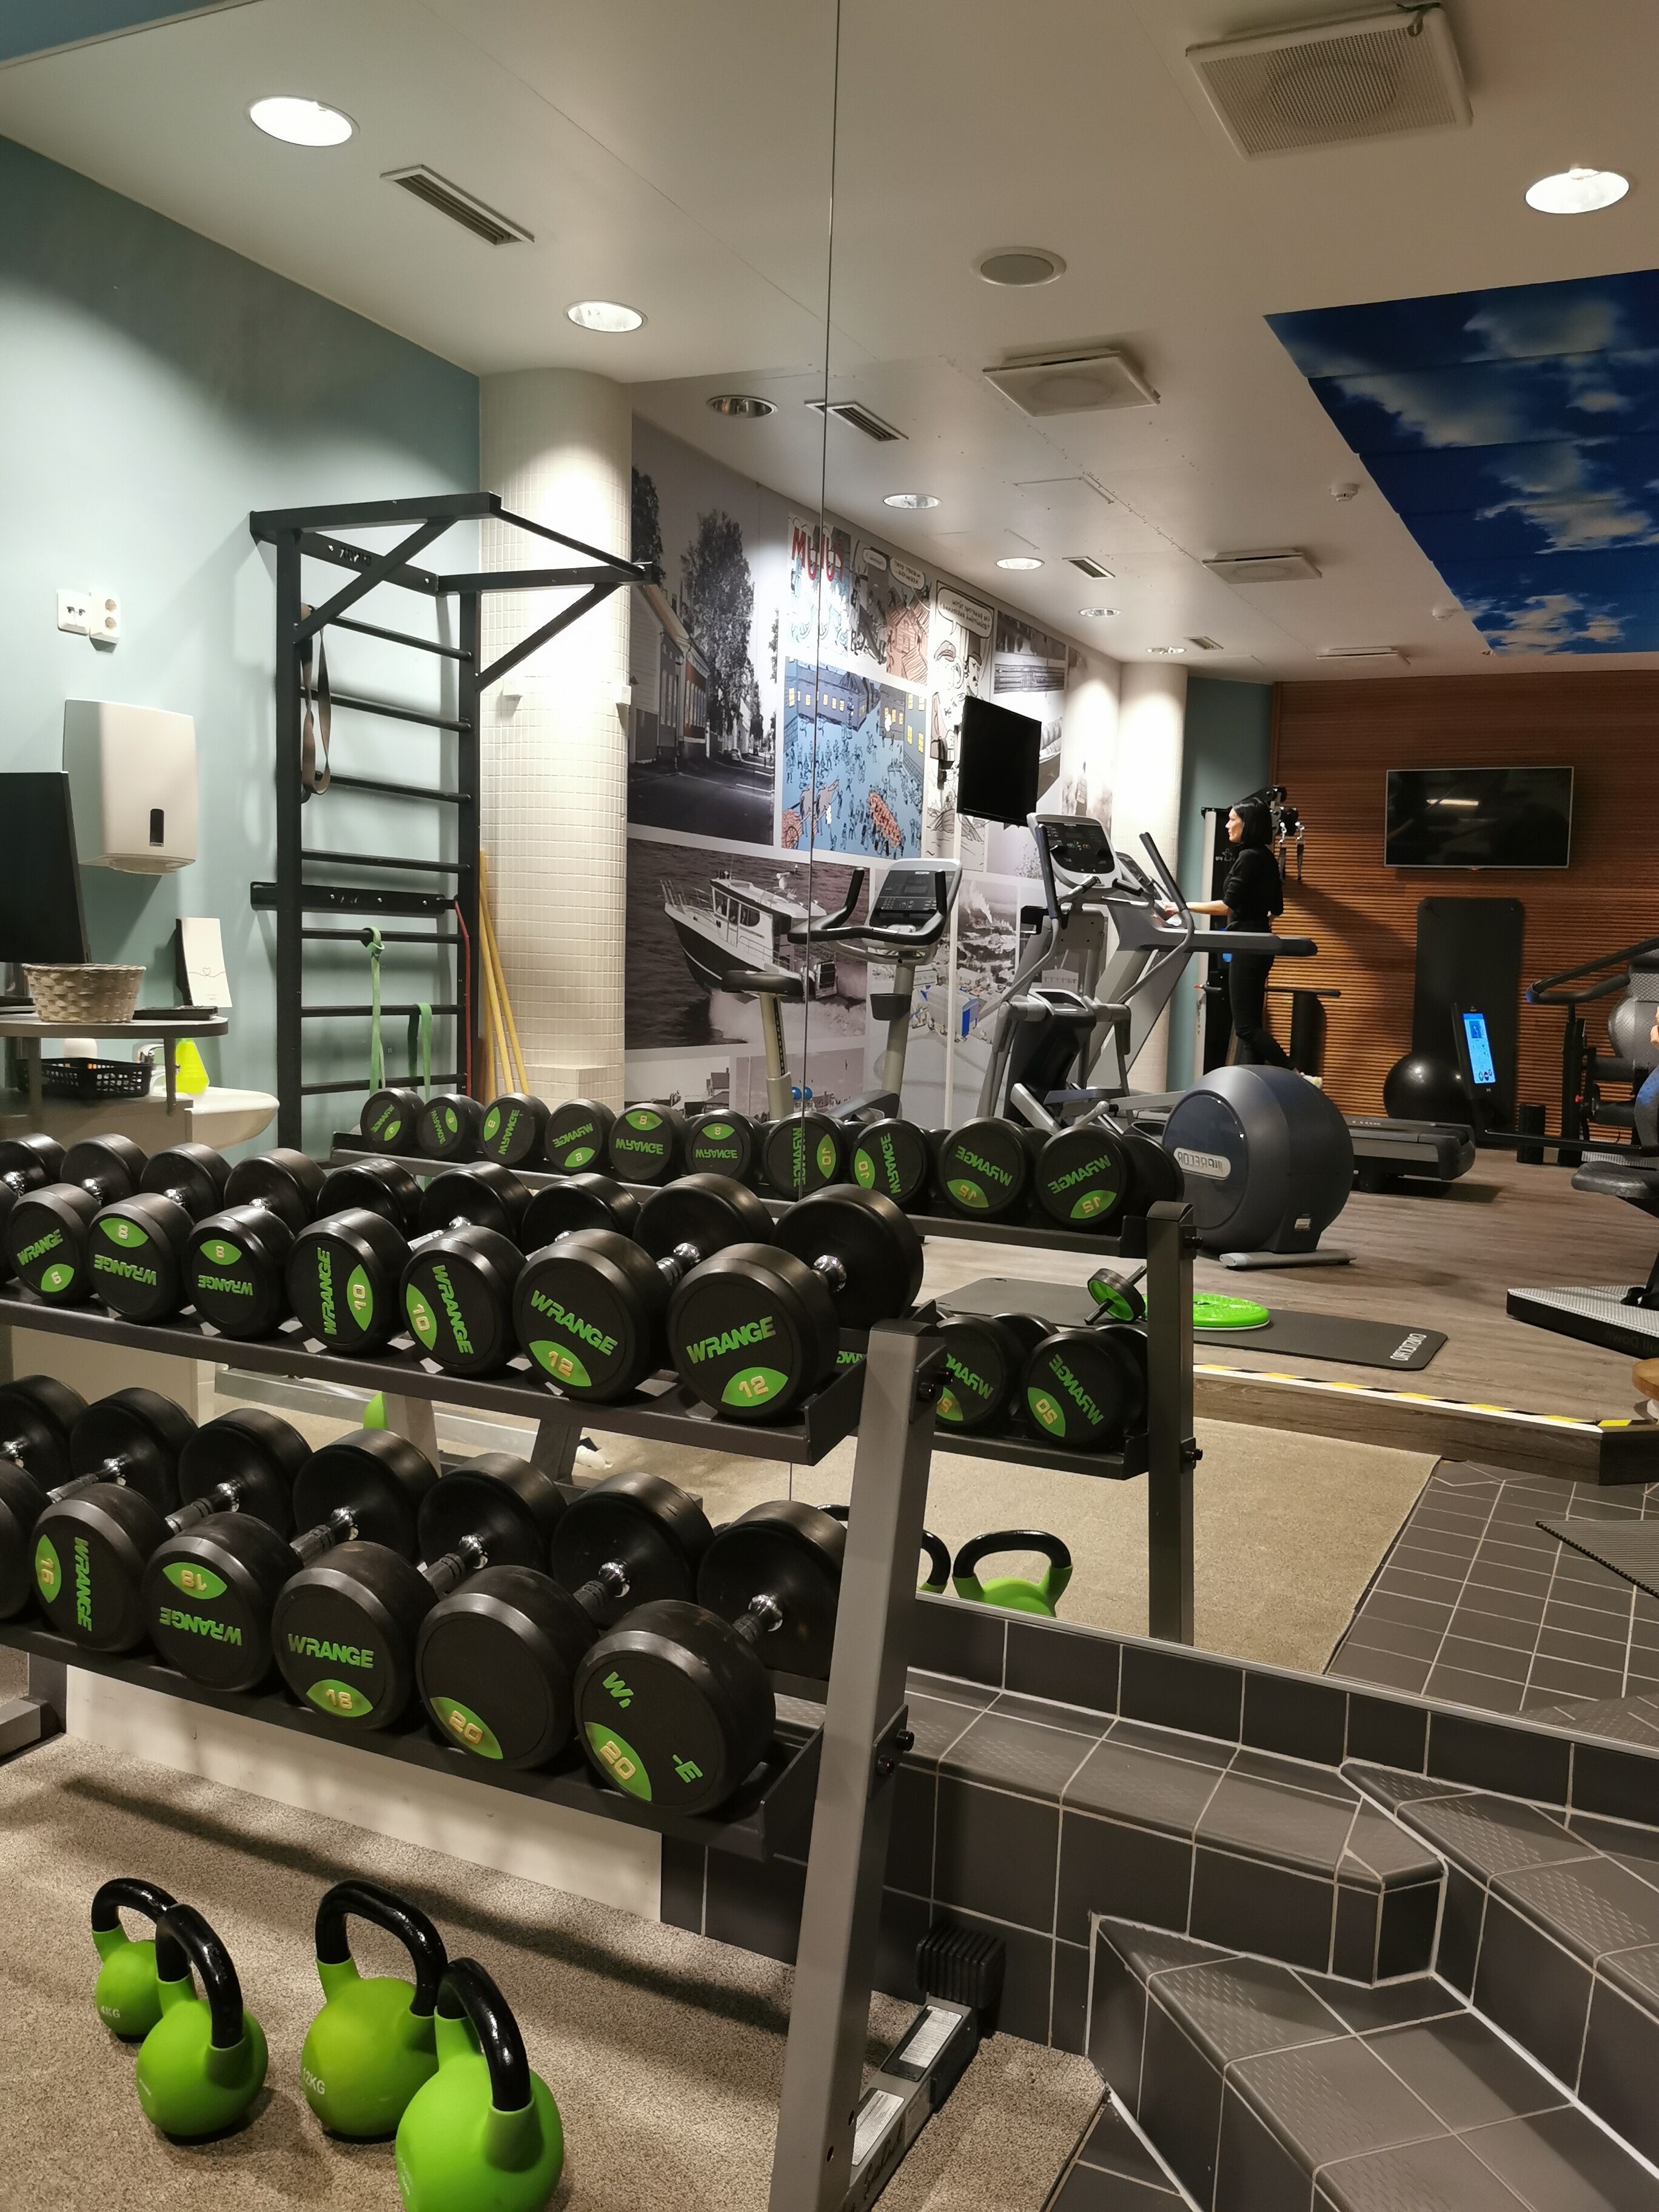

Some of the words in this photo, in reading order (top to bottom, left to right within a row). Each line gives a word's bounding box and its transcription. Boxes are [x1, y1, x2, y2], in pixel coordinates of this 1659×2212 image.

[16, 1228, 64, 1266] WRANGE
[118, 1225, 129, 1239] 8
[215, 1245, 224, 1259] 8
[93, 1254, 157, 1286] WRANGE
[197, 1275, 253, 1296] WRANGE
[317, 1247, 337, 1335] WRANGE
[352, 1284, 366, 1311] 10
[412, 1304, 431, 1332] 10
[431, 1264, 475, 1355] WRANGE
[528, 1290, 618, 1356] WRANGE
[686, 1316, 776, 1364] WRANGE
[548, 1350, 574, 1378] 12
[738, 1376, 769, 1398] 12
[39, 1558, 55, 1585] 16
[74, 1537, 92, 1631] WRANGE
[179, 1569, 206, 1592] 18
[159, 1606, 242, 1646] WRANGE
[289, 1634, 375, 1669] WRANGE
[324, 1689, 354, 1711] 18
[448, 1709, 484, 1744] 20
[598, 1740, 637, 1781] 20
[100, 2005, 121, 2019] 4KG
